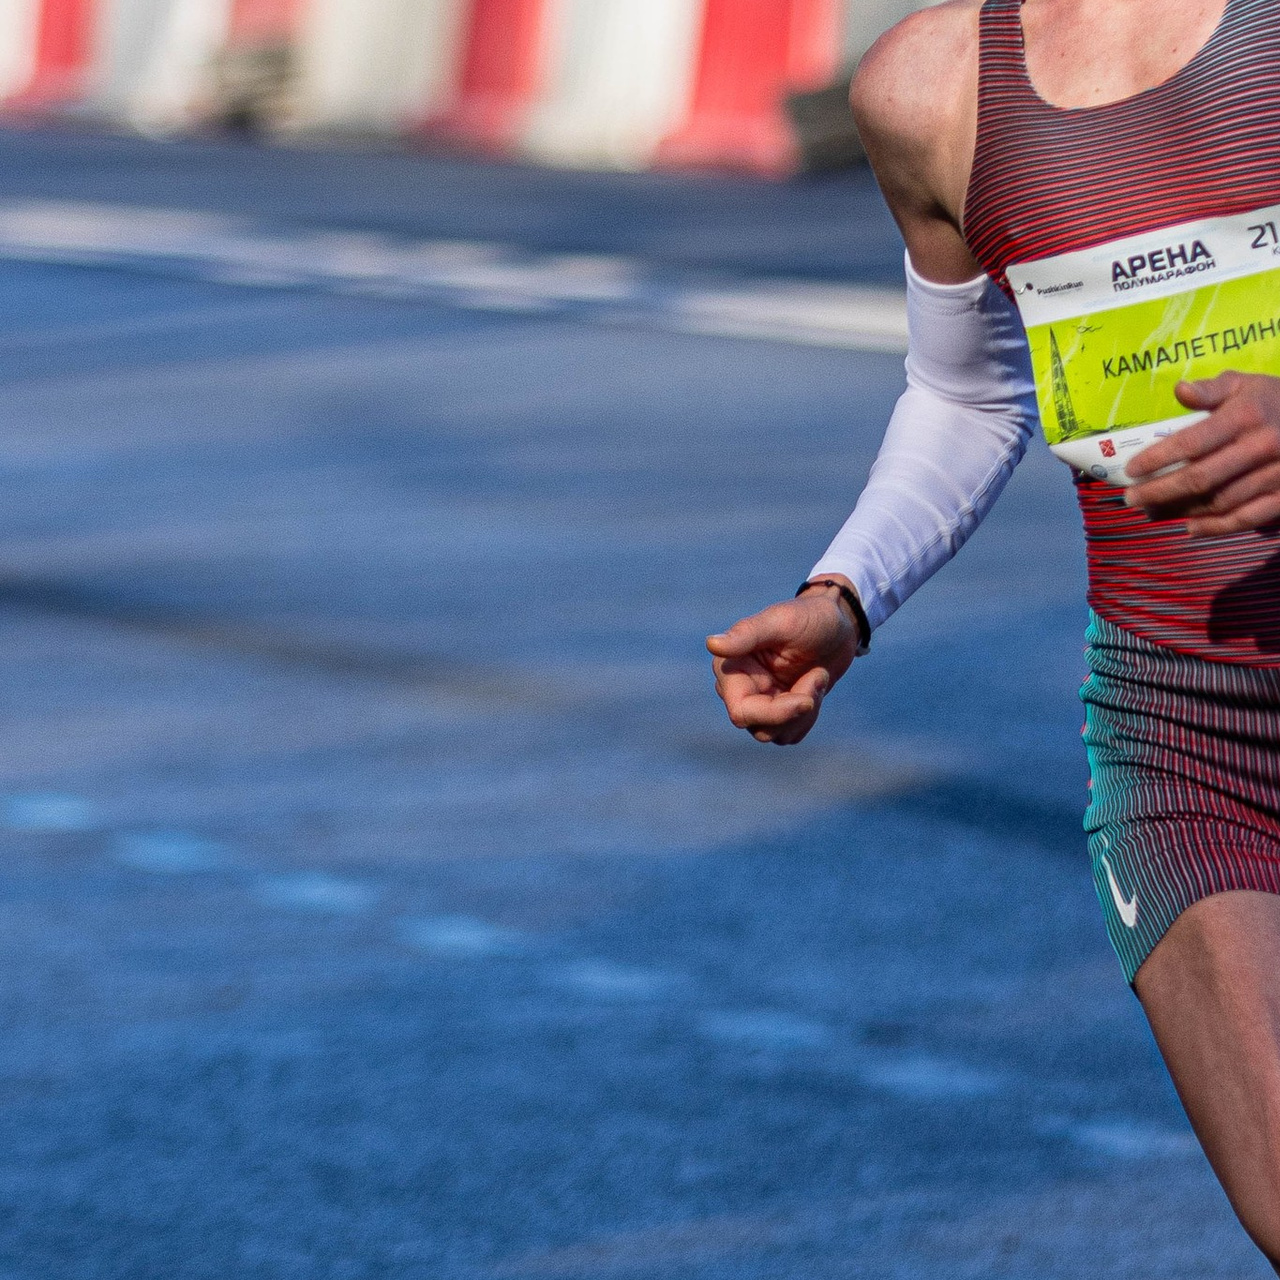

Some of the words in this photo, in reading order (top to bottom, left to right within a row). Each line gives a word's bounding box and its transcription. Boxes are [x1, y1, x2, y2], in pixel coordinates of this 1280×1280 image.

[1111, 239, 1213, 282] АРЕНА
[1113, 258, 1217, 292] ПОЛУМАРАФОН
[1037, 281, 1084, 295] PushkinRun
